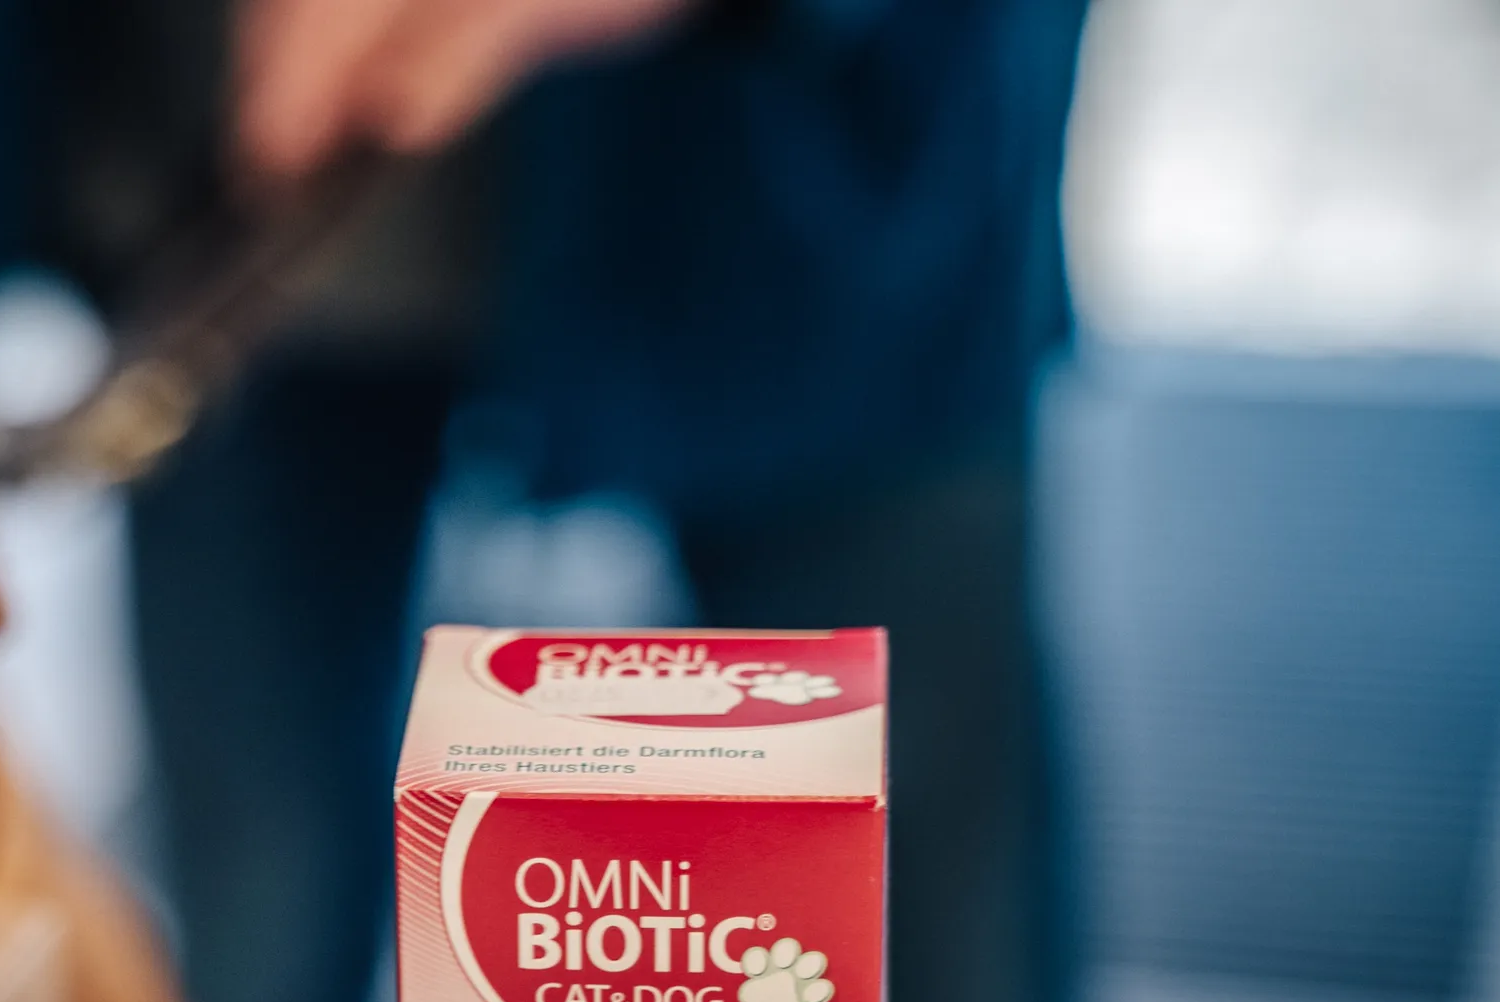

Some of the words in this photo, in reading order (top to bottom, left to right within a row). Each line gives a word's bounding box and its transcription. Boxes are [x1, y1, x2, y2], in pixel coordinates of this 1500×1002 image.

[447, 744, 583, 757] Stabilisiert
[592, 746, 630, 757] die
[639, 746, 766, 759] Darmflora
[444, 760, 507, 772] Ihres
[516, 761, 636, 774] Haustiers
[514, 857, 691, 910] OMNi
